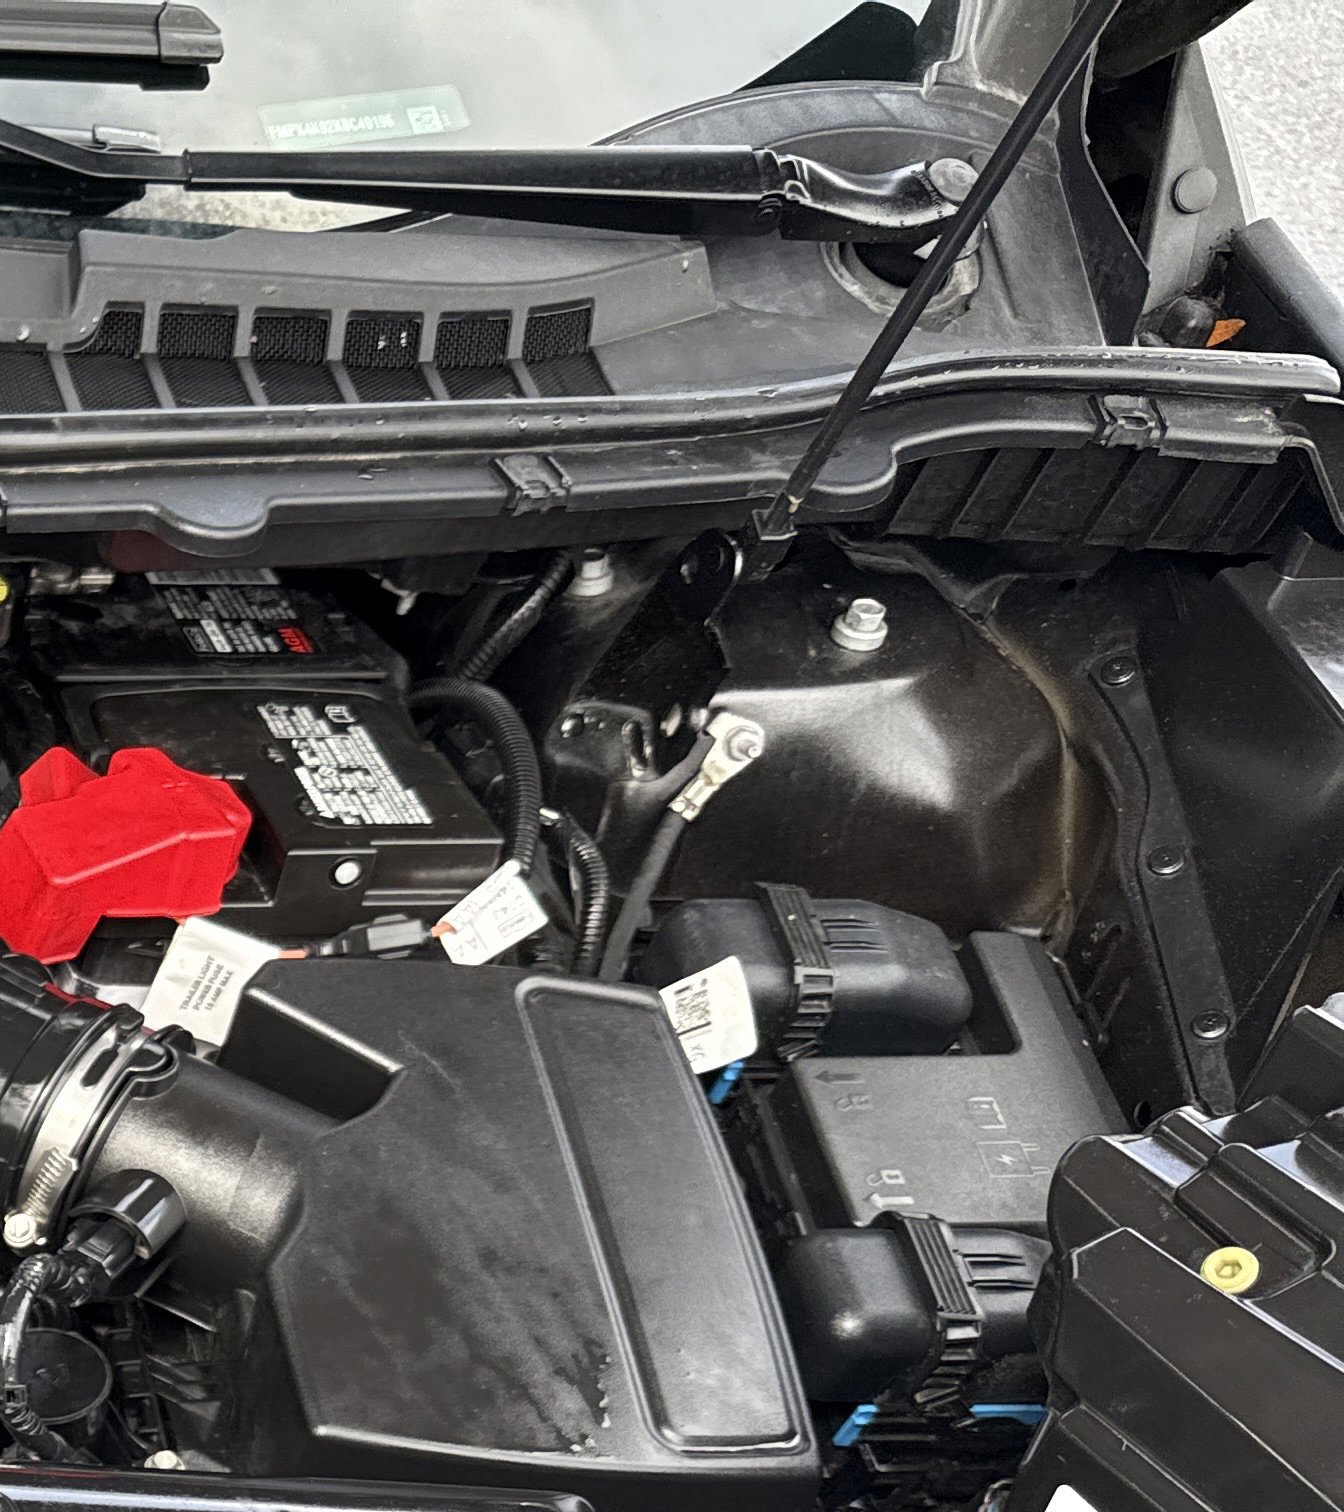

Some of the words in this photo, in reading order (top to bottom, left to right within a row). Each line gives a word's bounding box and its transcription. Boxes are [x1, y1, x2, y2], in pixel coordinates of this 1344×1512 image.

[179, 979, 202, 1010] TRAILER
[198, 955, 215, 980] LIGHT
[192, 984, 212, 1011] POWER
[208, 963, 224, 984] FUSE
